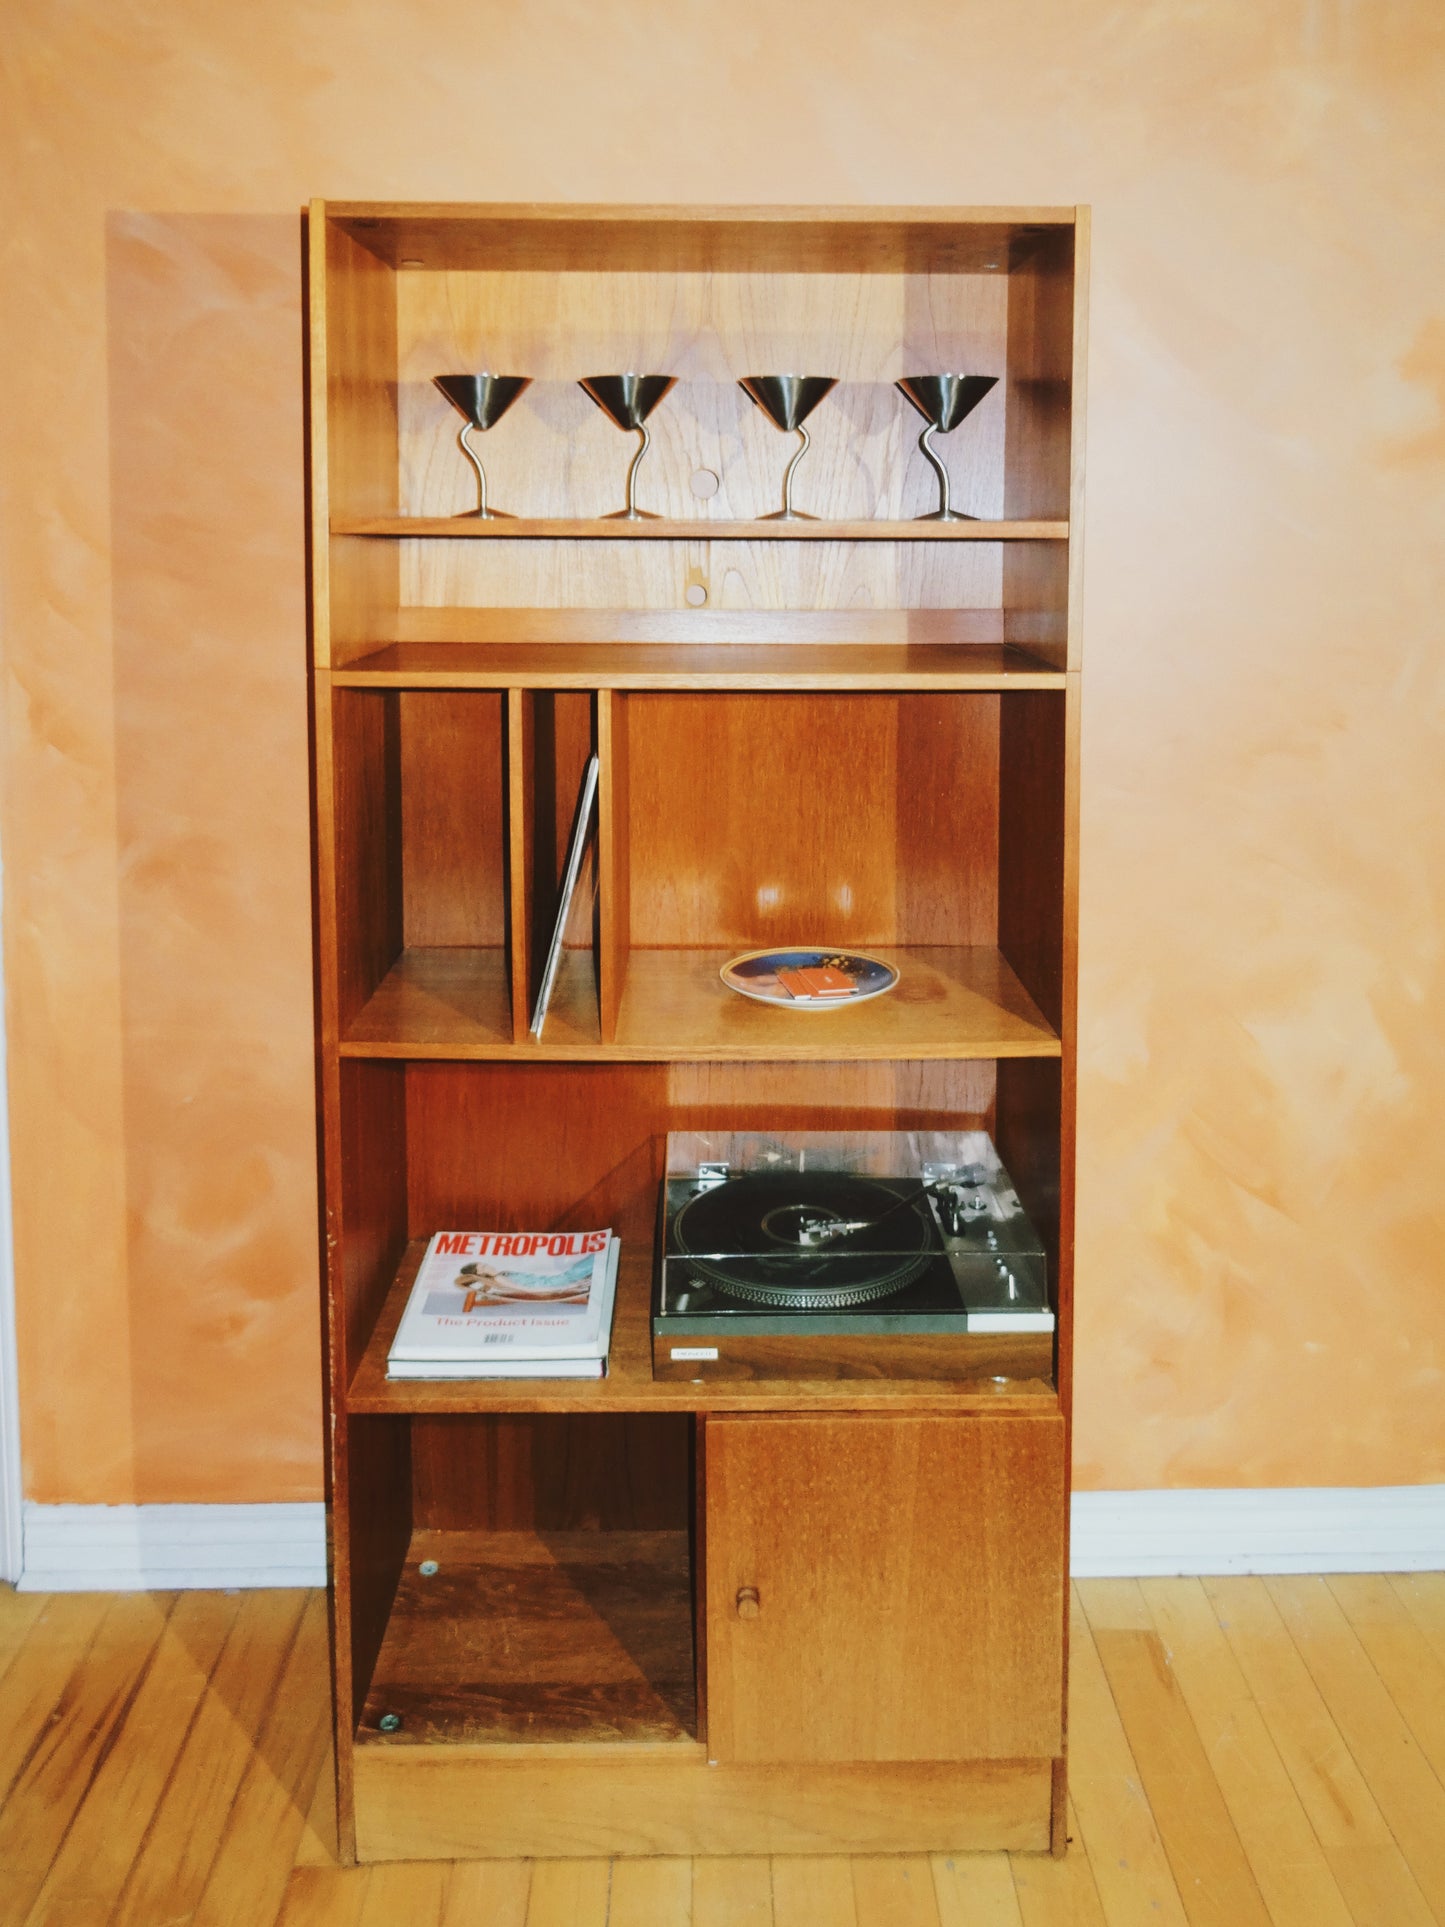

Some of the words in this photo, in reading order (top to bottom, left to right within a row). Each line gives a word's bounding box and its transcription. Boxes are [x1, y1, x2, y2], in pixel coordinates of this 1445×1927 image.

[435, 1232, 607, 1256] METROPOLIS
[437, 1317, 462, 1326] The
[466, 1318, 526, 1327] Product
